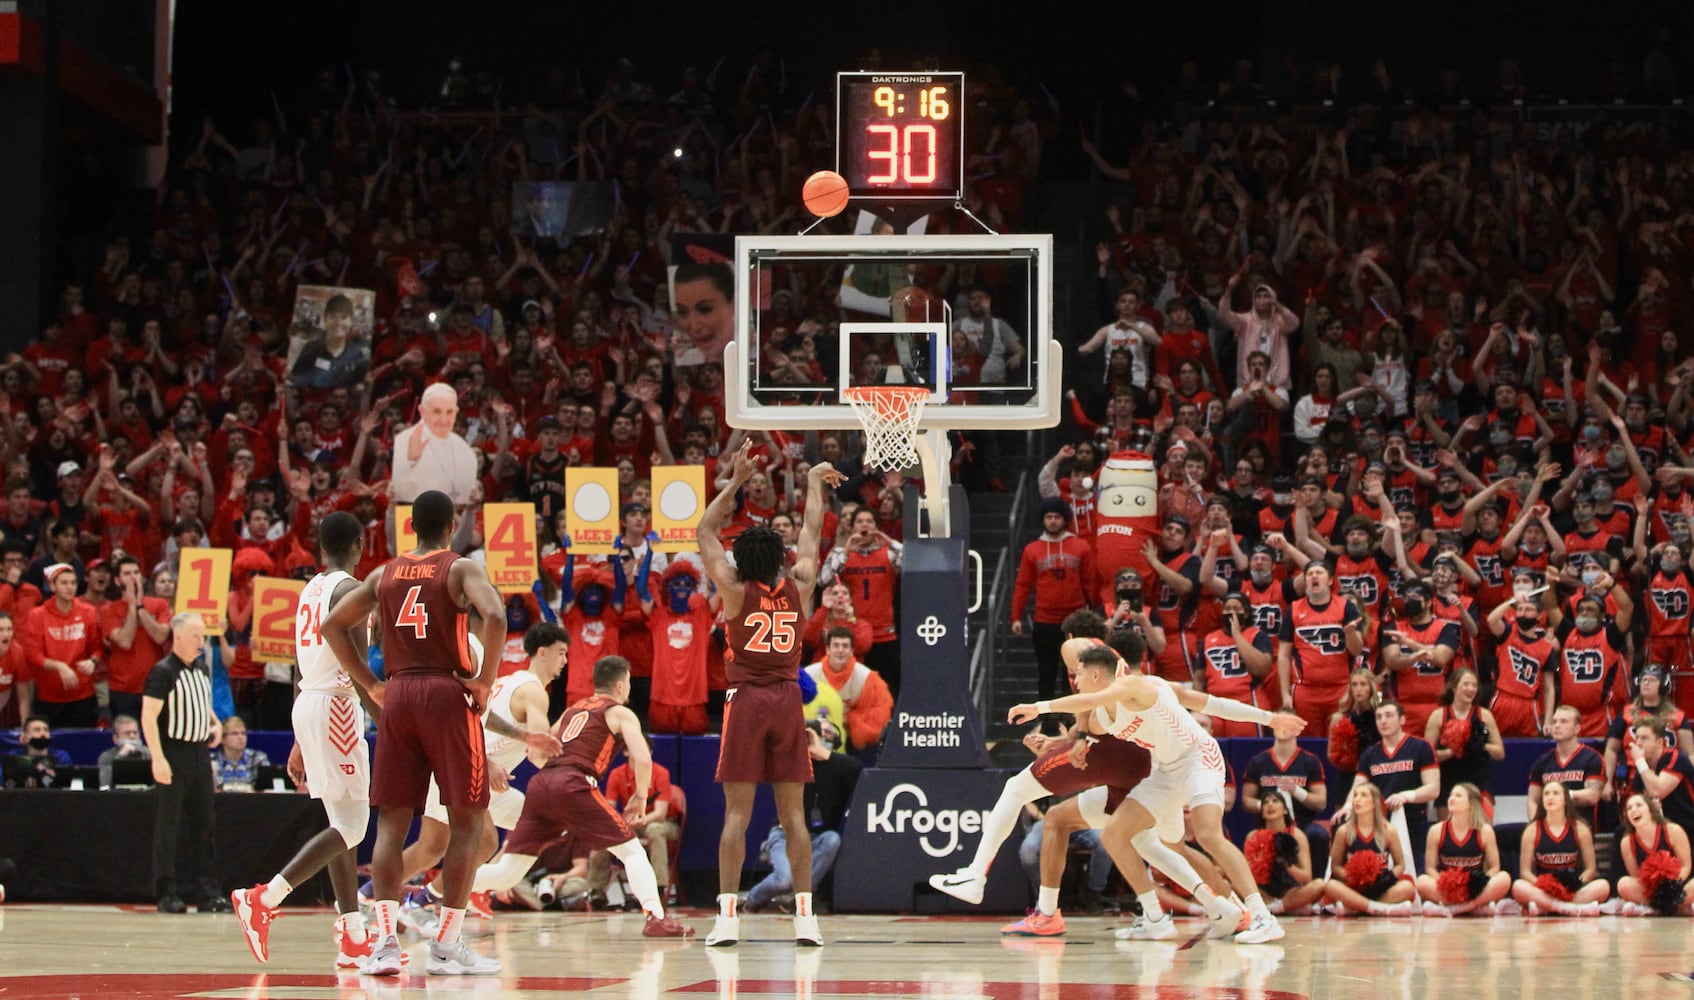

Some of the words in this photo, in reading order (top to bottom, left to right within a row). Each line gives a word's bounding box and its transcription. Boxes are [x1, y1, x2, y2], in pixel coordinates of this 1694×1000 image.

[871, 76, 933, 84] DAKTRONICS
[866, 124, 936, 184] 30
[489, 513, 534, 567] 4
[574, 529, 612, 541] LEE'S
[187, 558, 218, 610] 1
[393, 564, 436, 580] ALLEYNE
[494, 570, 531, 583] LEE'S
[862, 577, 870, 601] 1
[259, 588, 299, 640] 2
[395, 585, 428, 639] 4
[760, 596, 789, 610] MUTTS
[300, 602, 323, 647] 24
[744, 612, 798, 653] 25
[561, 710, 589, 743] 0
[899, 712, 965, 729] Premier
[904, 731, 960, 747] Health
[1370, 760, 1414, 777] DAYTON
